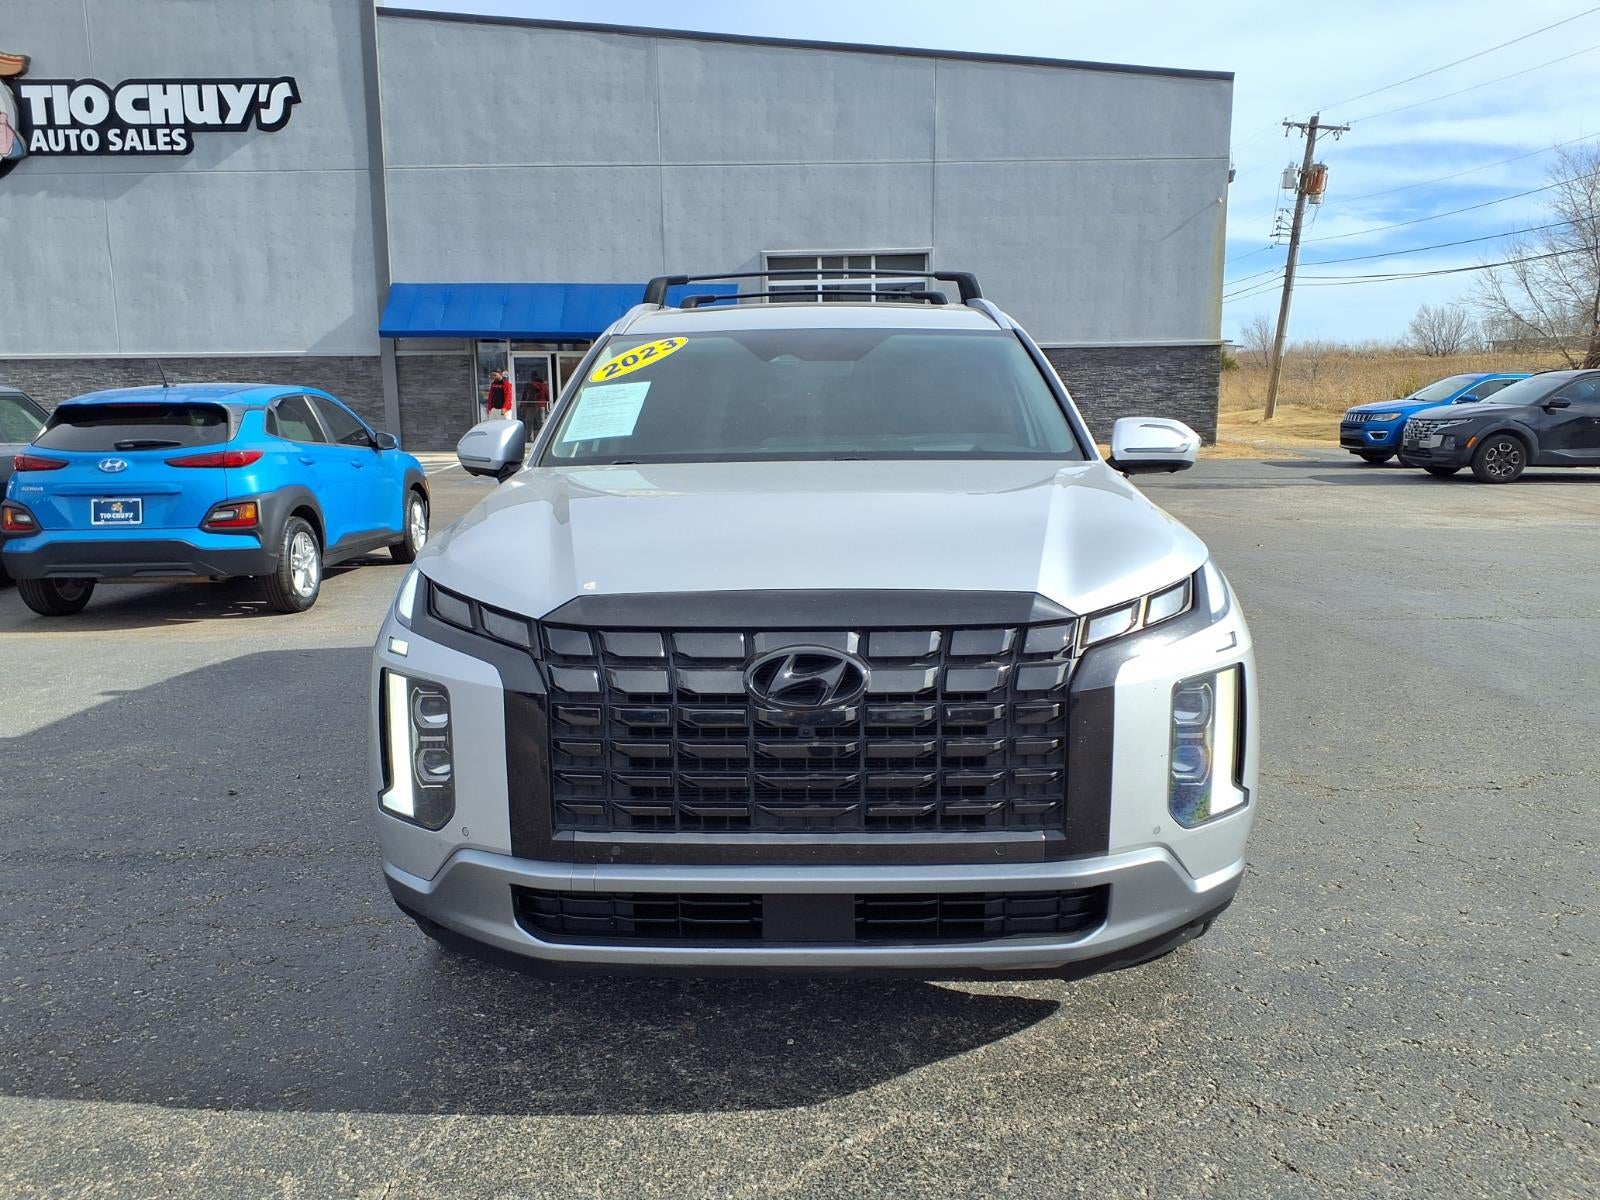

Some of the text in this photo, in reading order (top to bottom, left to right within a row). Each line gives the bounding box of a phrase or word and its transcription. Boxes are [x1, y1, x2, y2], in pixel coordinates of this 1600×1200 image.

[21, 81, 294, 126] TIO CHUY'S
[29, 127, 188, 152] AUTO SALES
[602, 339, 678, 378] 2023
